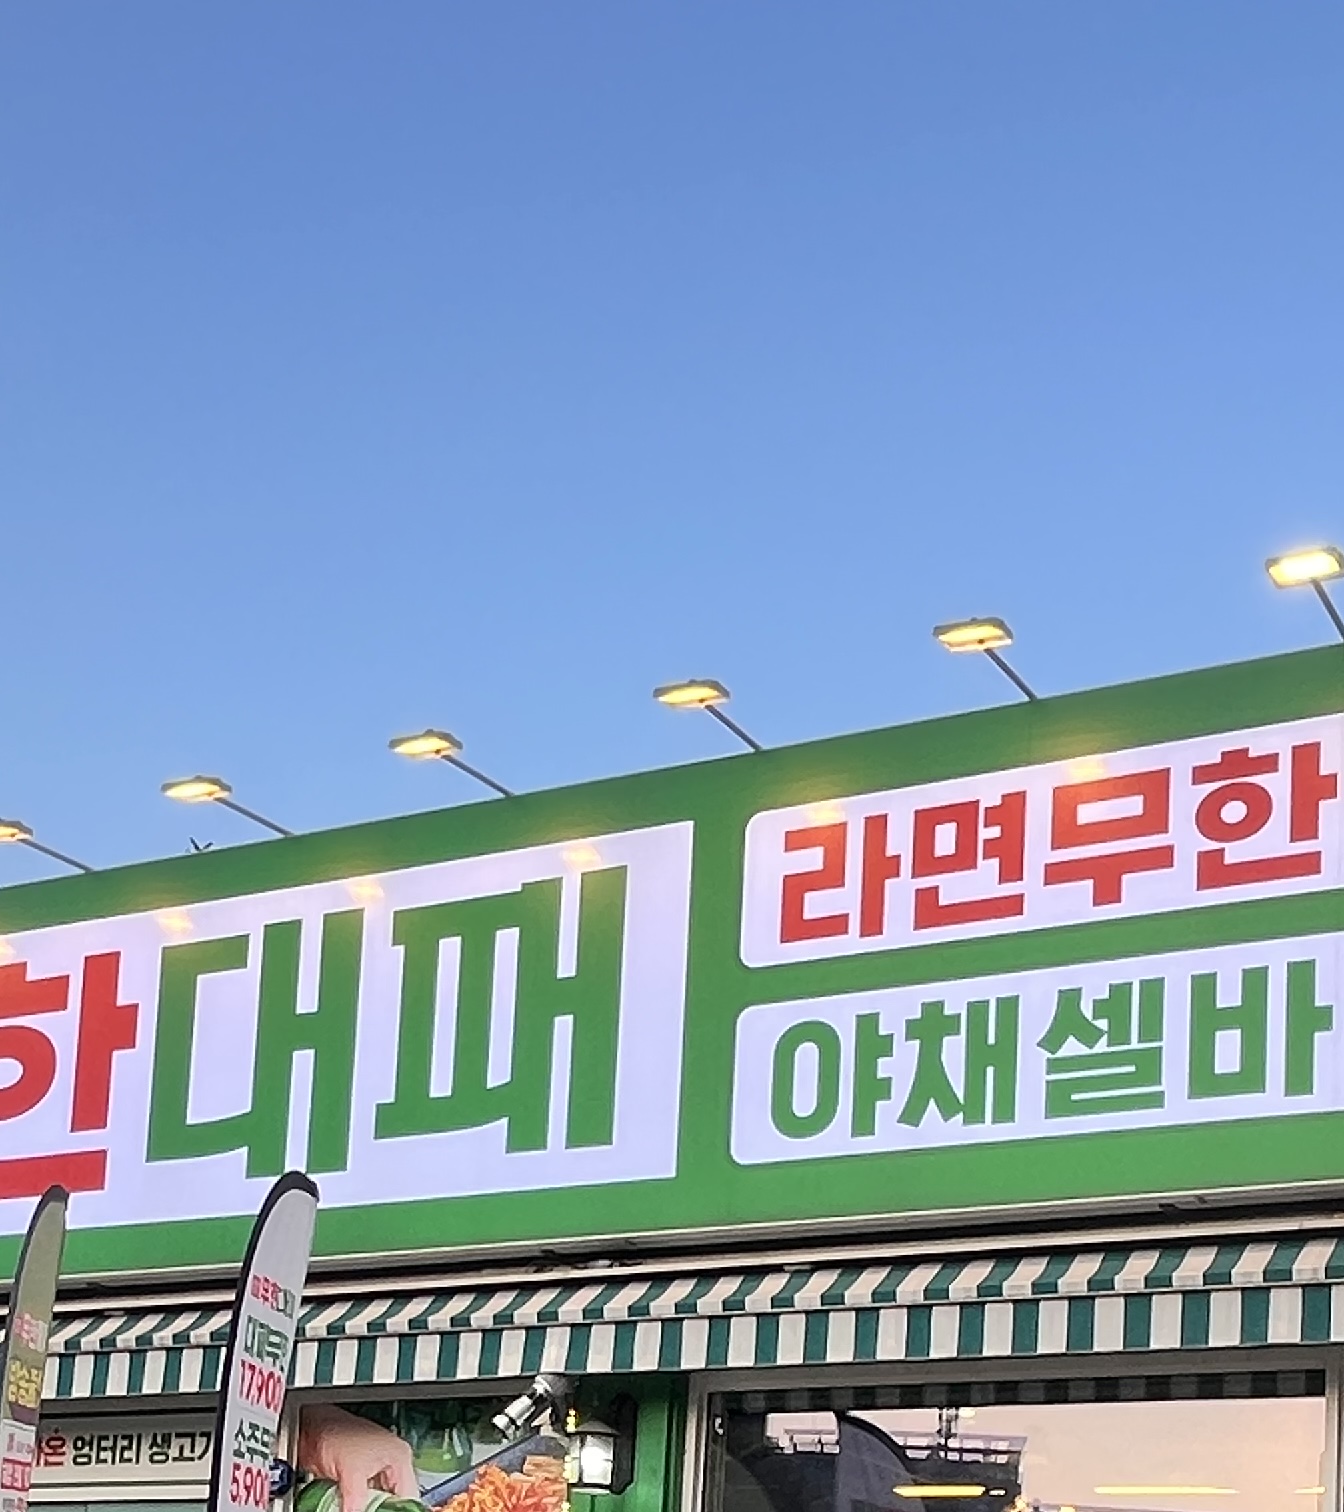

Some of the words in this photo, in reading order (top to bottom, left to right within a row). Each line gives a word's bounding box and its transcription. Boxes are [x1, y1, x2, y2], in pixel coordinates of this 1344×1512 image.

[780, 742, 1337, 943] 라면무한
[770, 958, 1334, 1139] 야채셀바
[73, 1434, 139, 1466] 엉터리
